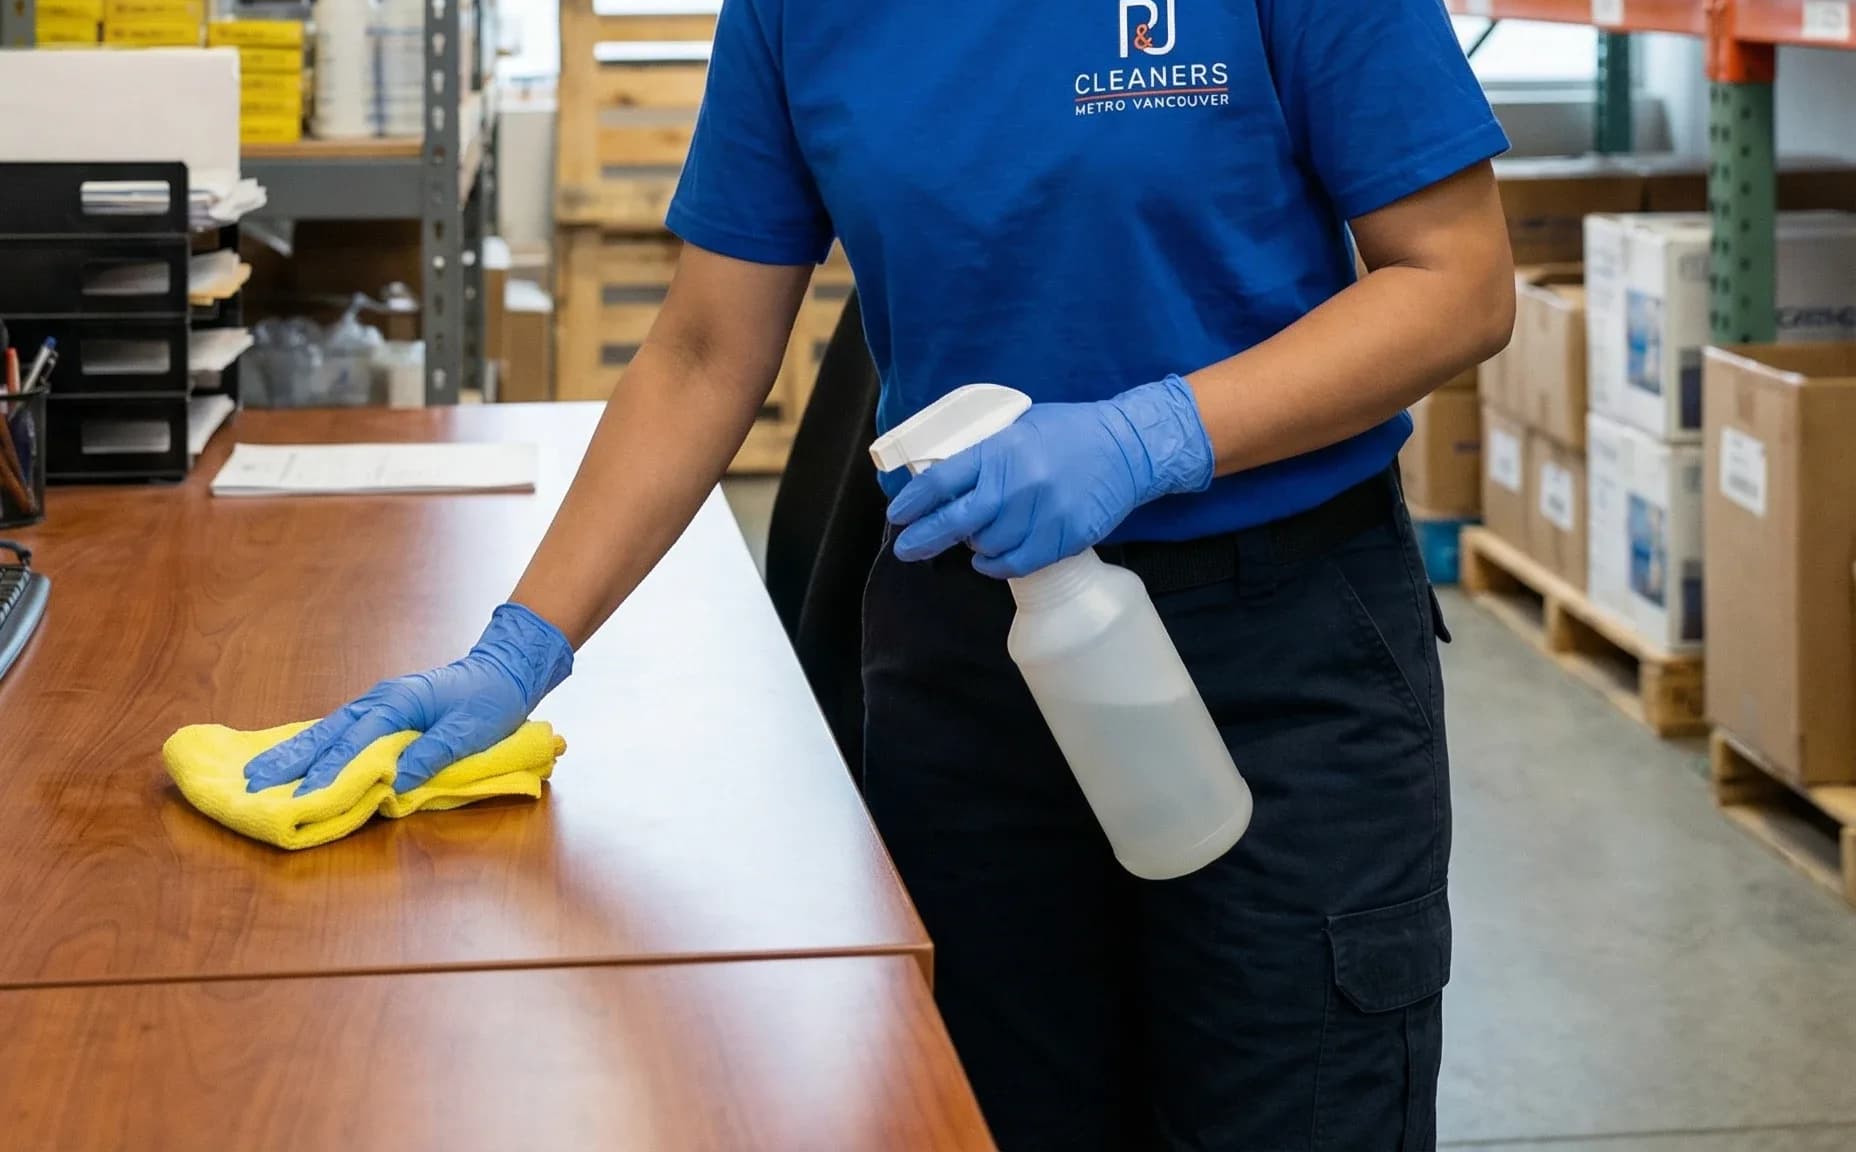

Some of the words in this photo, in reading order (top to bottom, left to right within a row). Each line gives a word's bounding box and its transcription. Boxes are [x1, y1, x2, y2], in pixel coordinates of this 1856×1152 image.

[1075, 62, 1228, 95] CLEANERS
[1075, 100, 1126, 116] METRO
[1133, 94, 1229, 110] VANCOUVER
